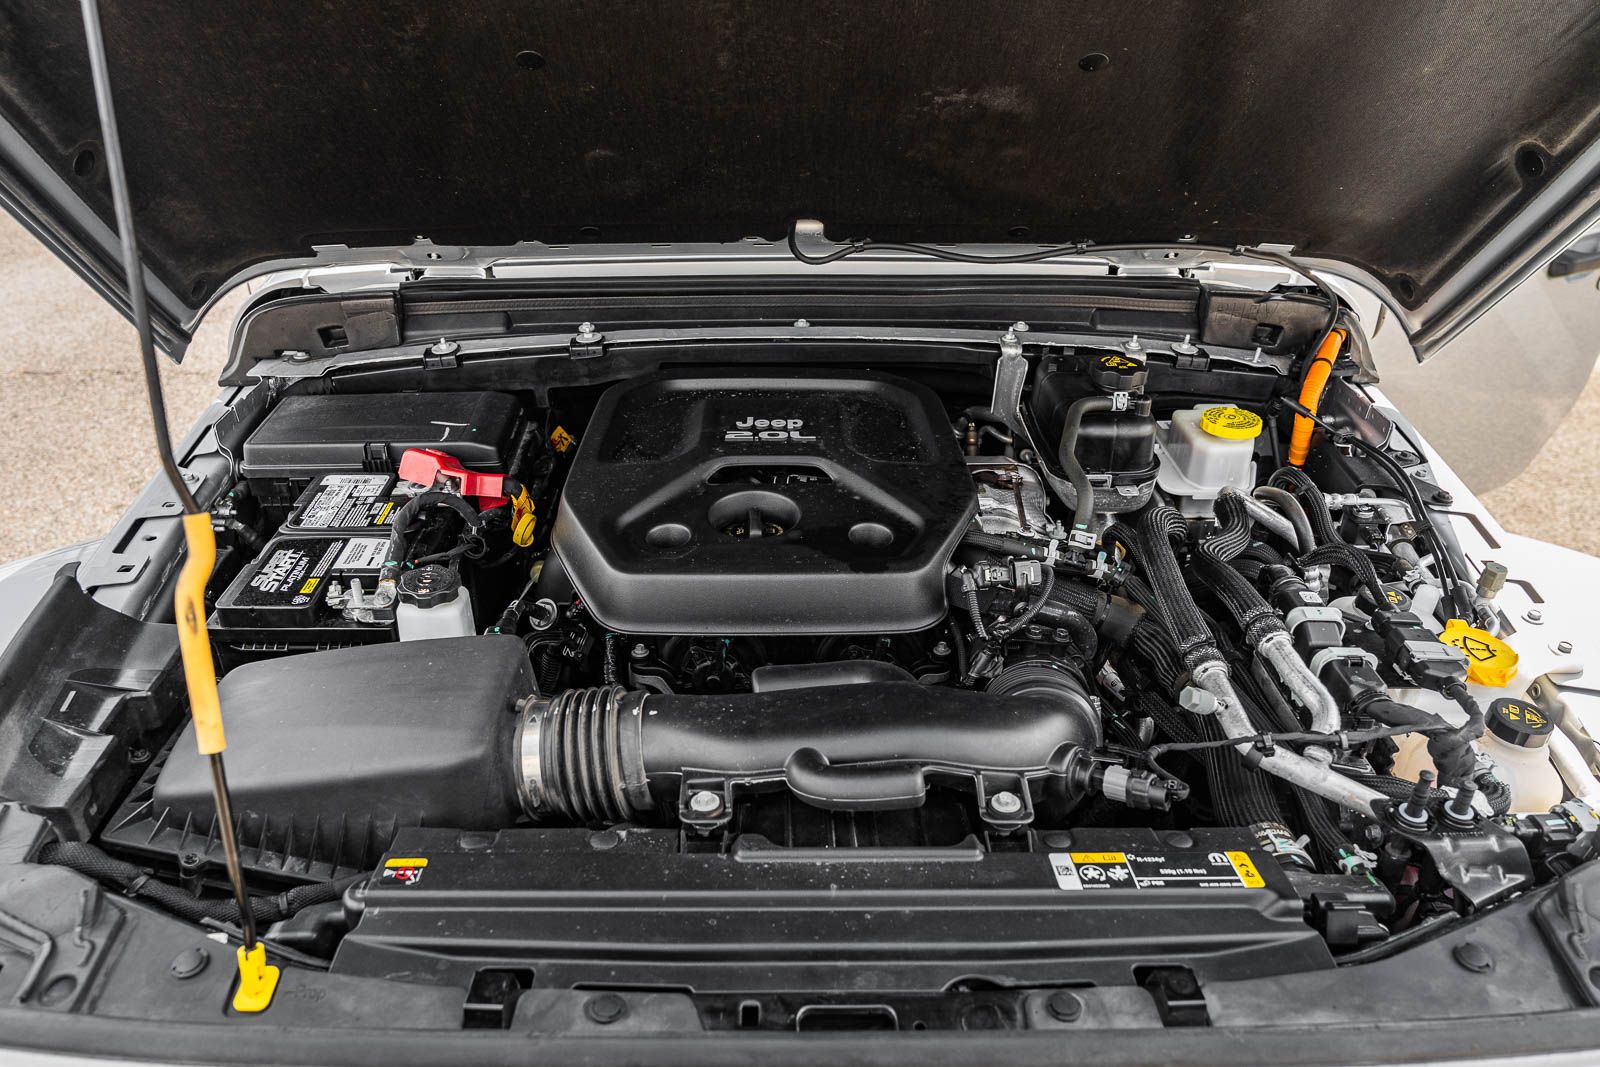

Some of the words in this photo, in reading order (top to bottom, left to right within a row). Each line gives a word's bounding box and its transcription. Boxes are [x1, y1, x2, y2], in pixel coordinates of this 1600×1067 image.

[725, 431, 817, 442] 2.0L
[736, 416, 803, 429] Jeep
[250, 549, 290, 587] SUPER
[259, 549, 300, 592] START
[280, 557, 310, 592] PLATINUM
